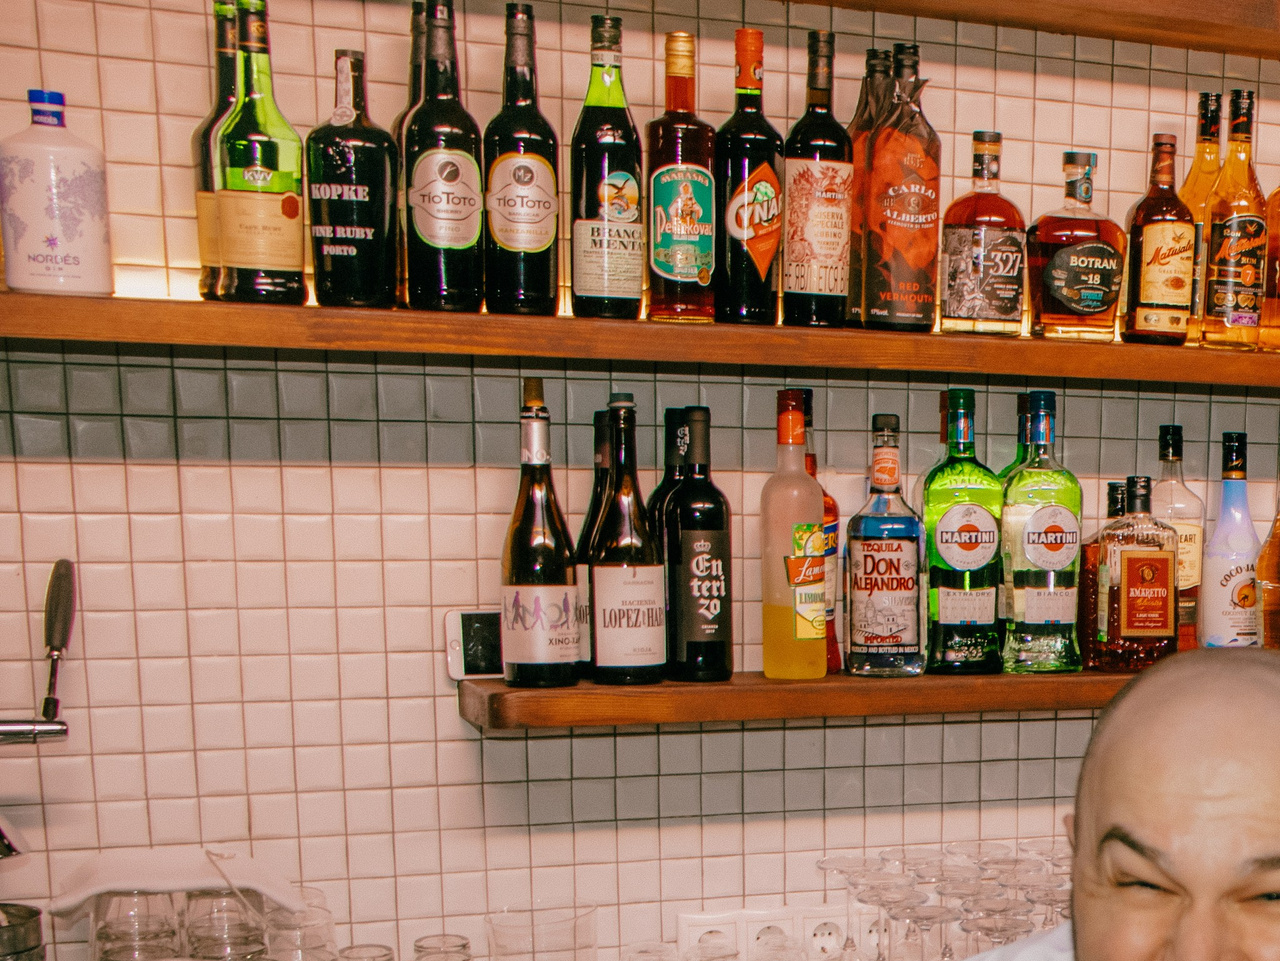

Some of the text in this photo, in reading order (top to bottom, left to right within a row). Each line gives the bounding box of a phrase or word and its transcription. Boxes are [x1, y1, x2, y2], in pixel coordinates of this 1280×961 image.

[243, 169, 273, 181] KWV
[311, 184, 369, 201] KOPKE
[888, 184, 936, 199] CARLO
[725, 191, 781, 240] CYNA
[883, 209, 938, 223] ALBERTO
[334, 226, 374, 240] RUBY
[590, 226, 642, 239] BRANC
[323, 244, 357, 256] PORTO
[28, 253, 80, 266] NORDÉS
[1070, 255, 1117, 270] BOTRAN
[899, 282, 920, 291] RED
[880, 292, 933, 303] VERMOUTH
[941, 531, 995, 543] MARTINI
[1028, 532, 1077, 544] MARTINI
[861, 543, 903, 553] TEQUILA
[863, 554, 901, 576] DON
[852, 573, 915, 597] ALEJANDRO
[1129, 588, 1167, 598] AMARETTO
[603, 608, 641, 628] LOPEZ
